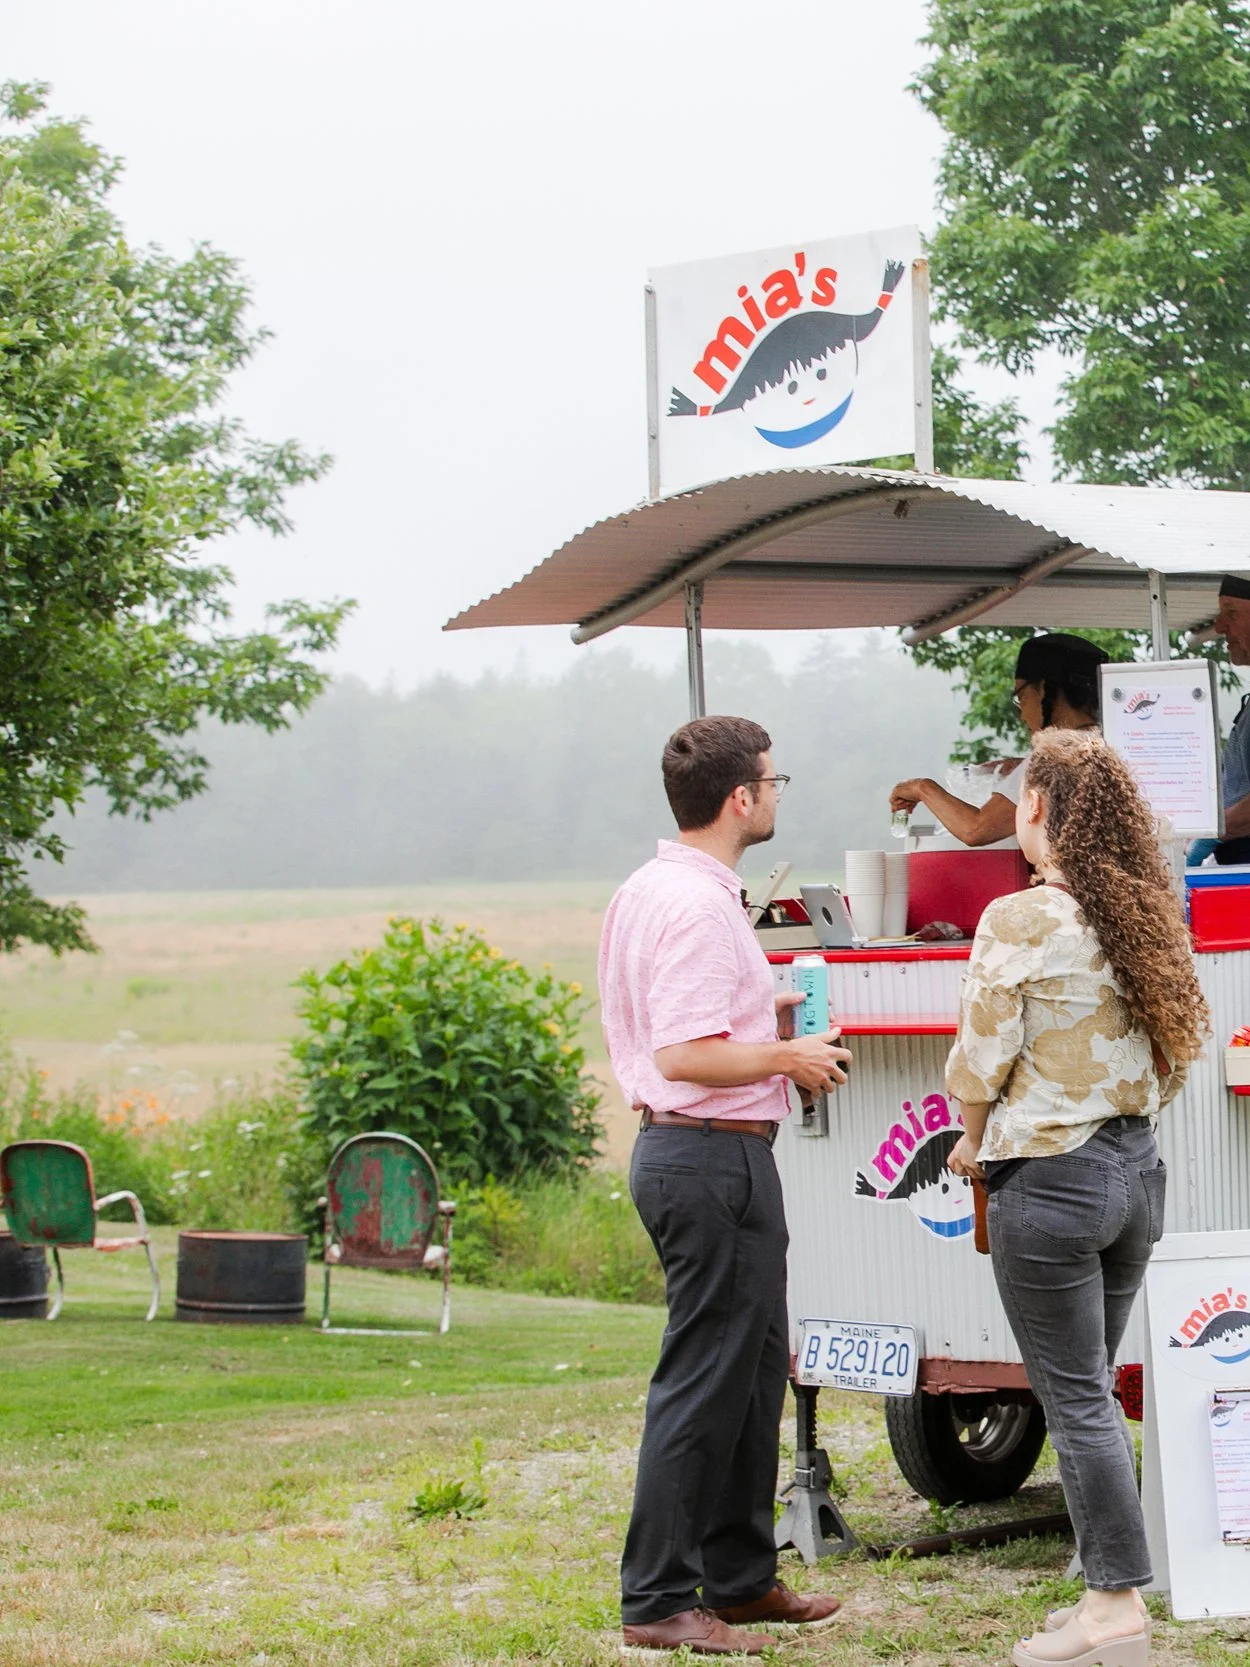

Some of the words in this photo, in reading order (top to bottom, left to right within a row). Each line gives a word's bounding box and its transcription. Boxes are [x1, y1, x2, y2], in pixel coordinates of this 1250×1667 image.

[692, 251, 838, 396] mia's
[1127, 689, 1150, 712] mia's
[872, 1093, 965, 1184] mia
[840, 1326, 882, 1339] MAINE
[1179, 1287, 1248, 1340] mia's
[804, 1335, 821, 1369] B
[826, 1336, 910, 1377] 529120
[833, 1374, 878, 1389] TRAILER
